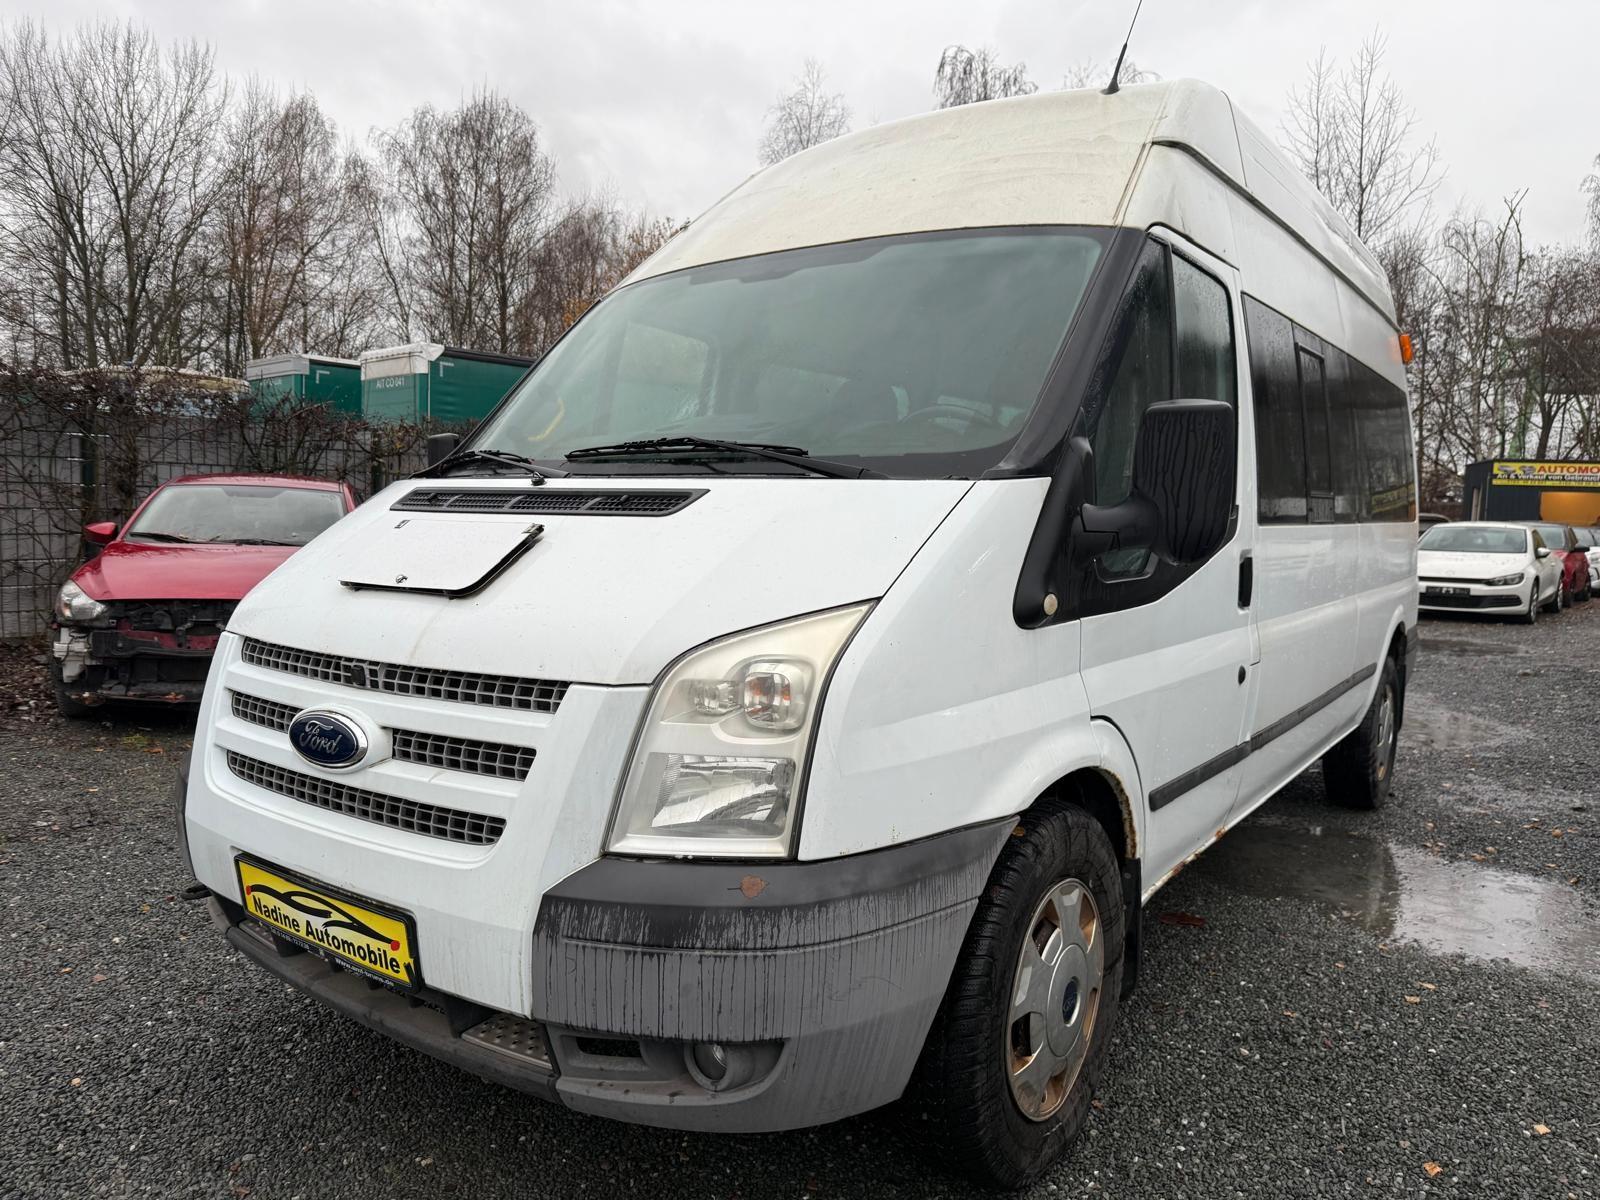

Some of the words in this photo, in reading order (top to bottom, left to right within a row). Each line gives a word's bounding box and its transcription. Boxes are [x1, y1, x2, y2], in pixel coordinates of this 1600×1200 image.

[299, 720, 343, 755] Ford
[252, 894, 301, 933] Nadine
[305, 919, 401, 974] Automobile
